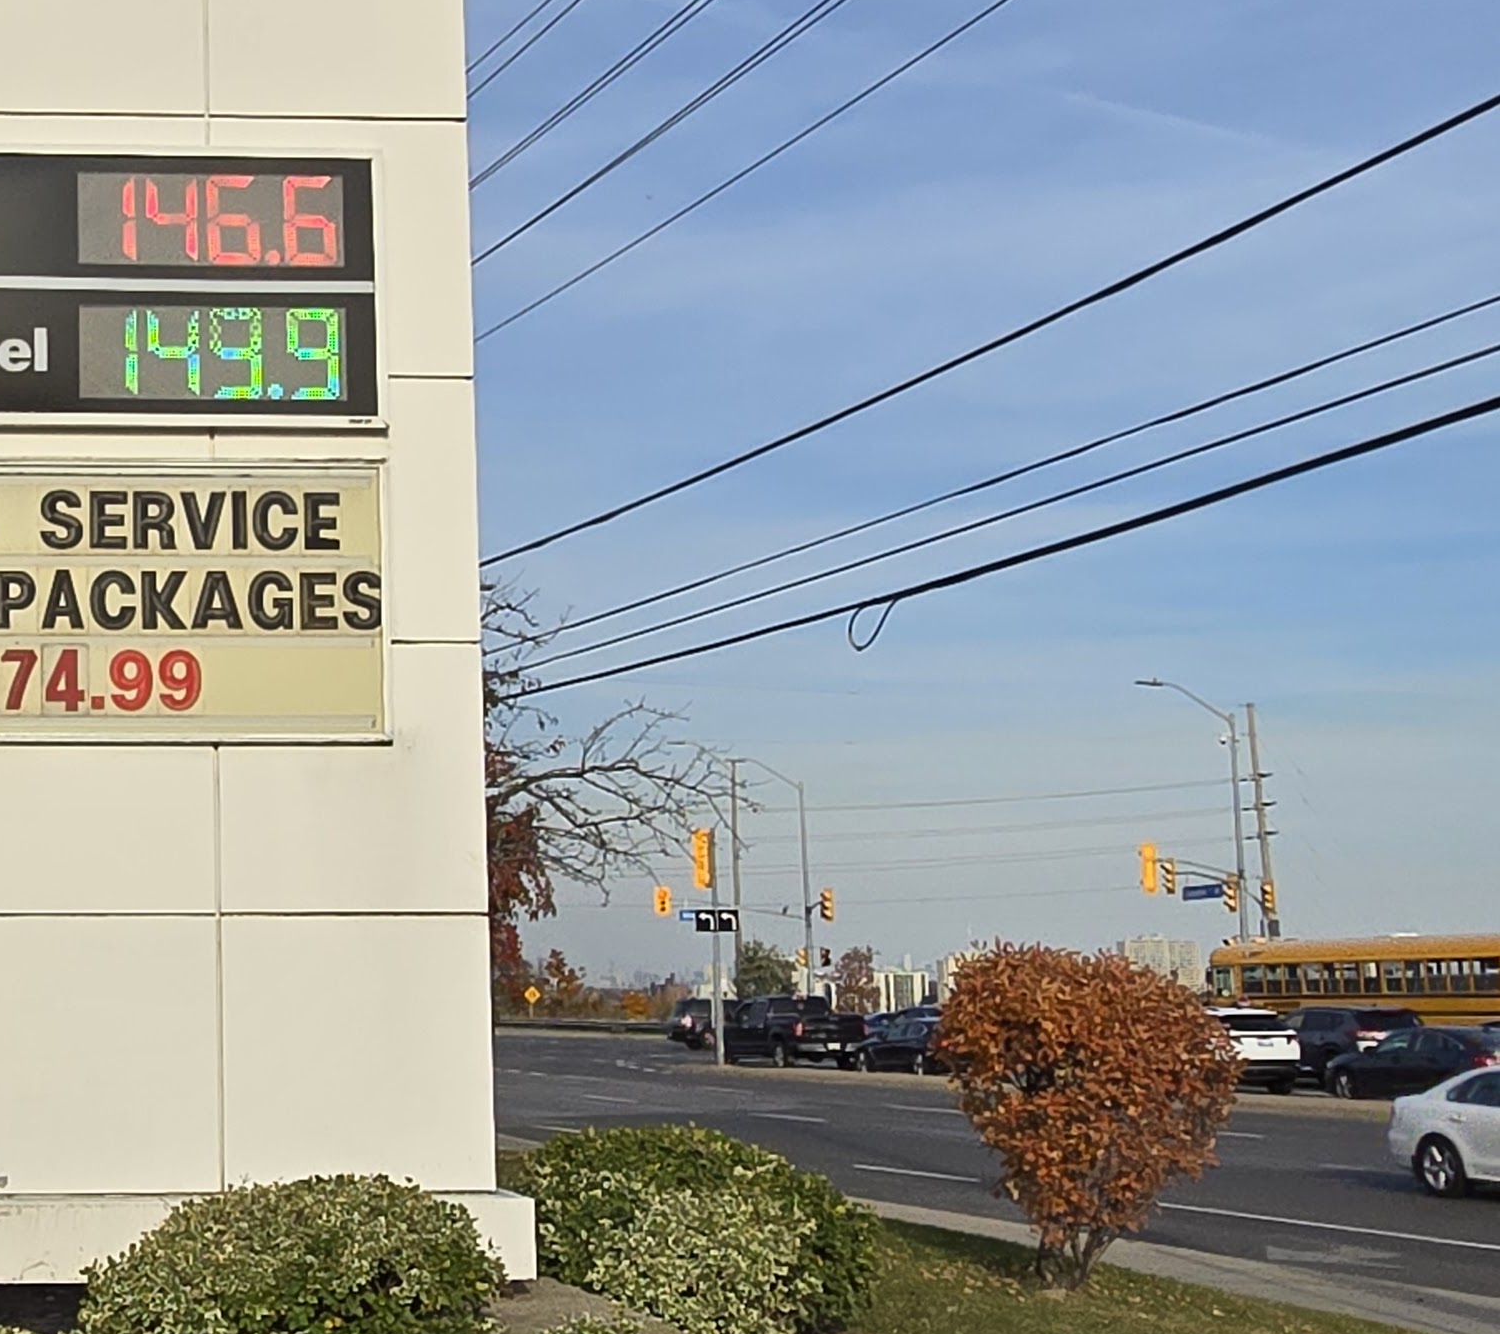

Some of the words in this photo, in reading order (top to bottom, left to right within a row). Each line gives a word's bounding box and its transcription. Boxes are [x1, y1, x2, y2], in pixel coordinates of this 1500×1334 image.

[122, 175, 338, 265] 146.6
[123, 306, 343, 401] 149.9
[40, 489, 342, 551] SERVICE
[0, 647, 203, 713] 74.99
